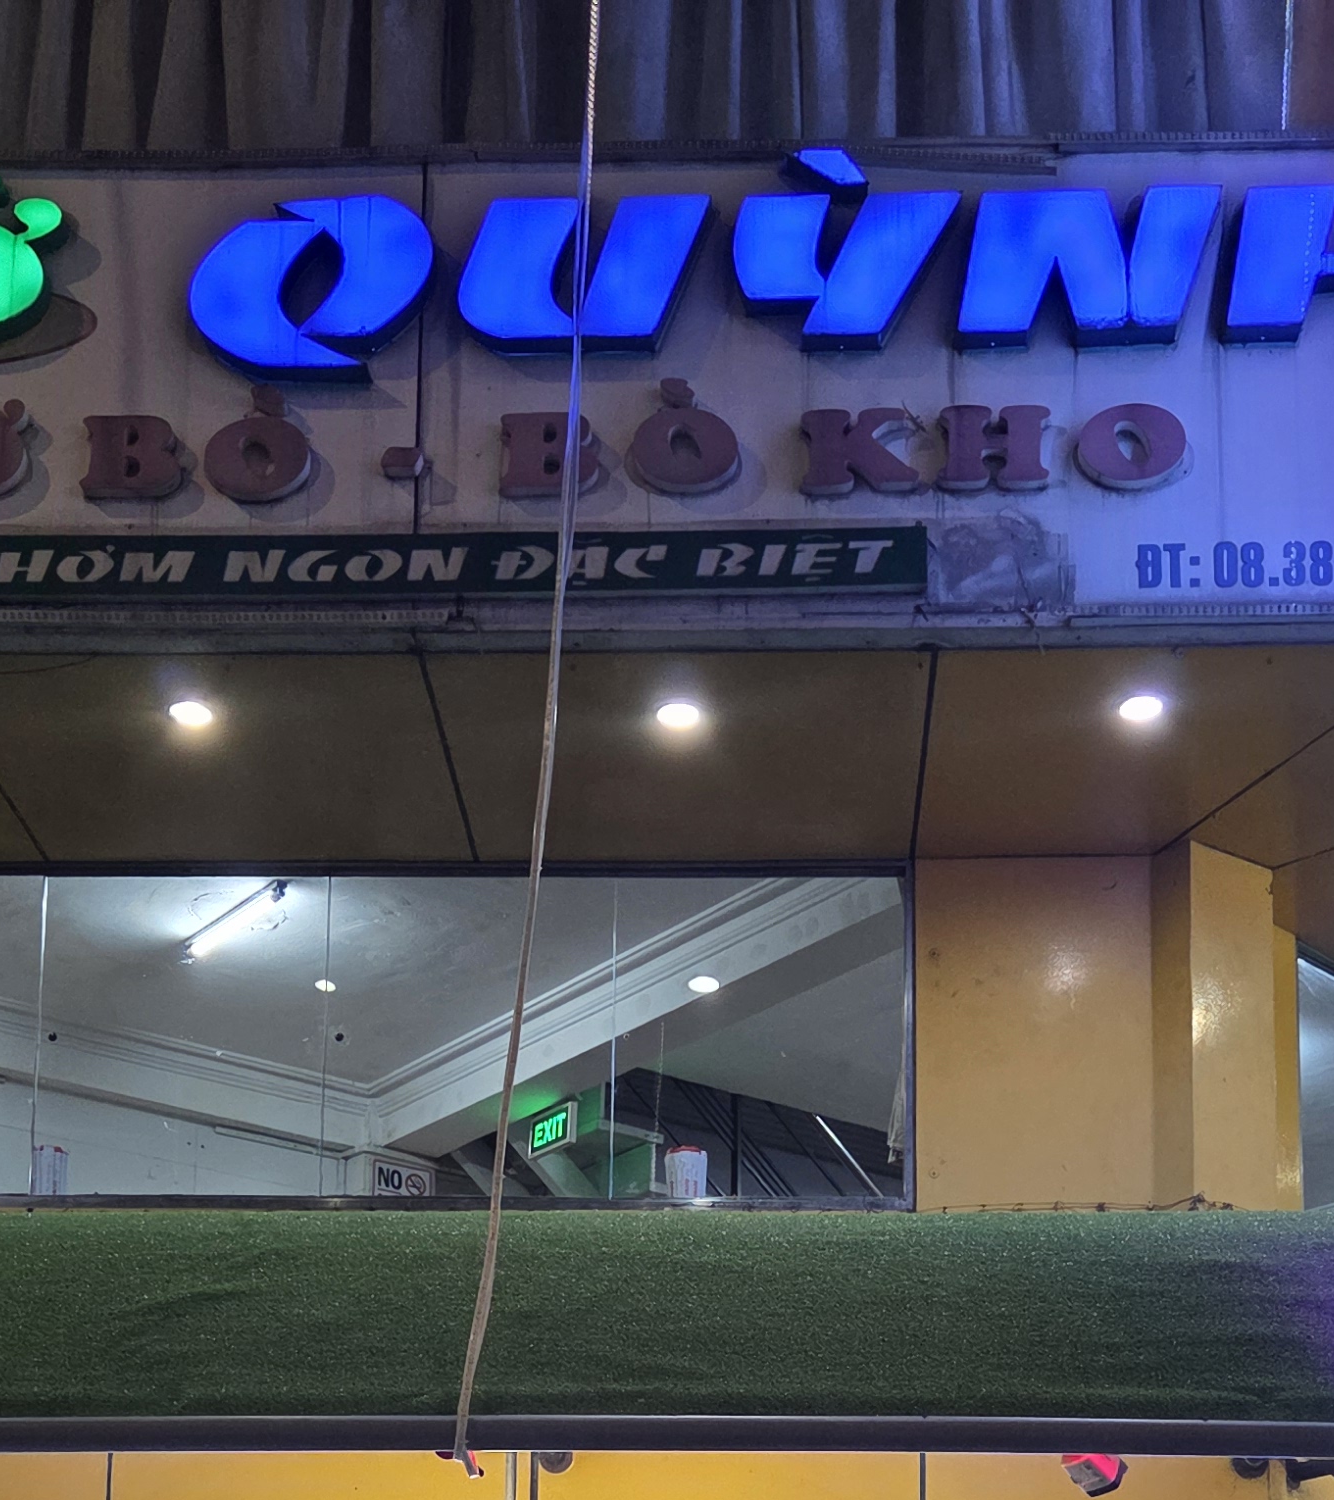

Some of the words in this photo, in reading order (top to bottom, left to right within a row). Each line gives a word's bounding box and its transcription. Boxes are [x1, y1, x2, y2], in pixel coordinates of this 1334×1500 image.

[799, 402, 1189, 493] KHO
[223, 546, 468, 583] NGON
[696, 533, 894, 583] BIỆT
[1135, 542, 1202, 588] ĐT:
[533, 1111, 567, 1148] EXIT
[377, 1166, 403, 1190] NO
